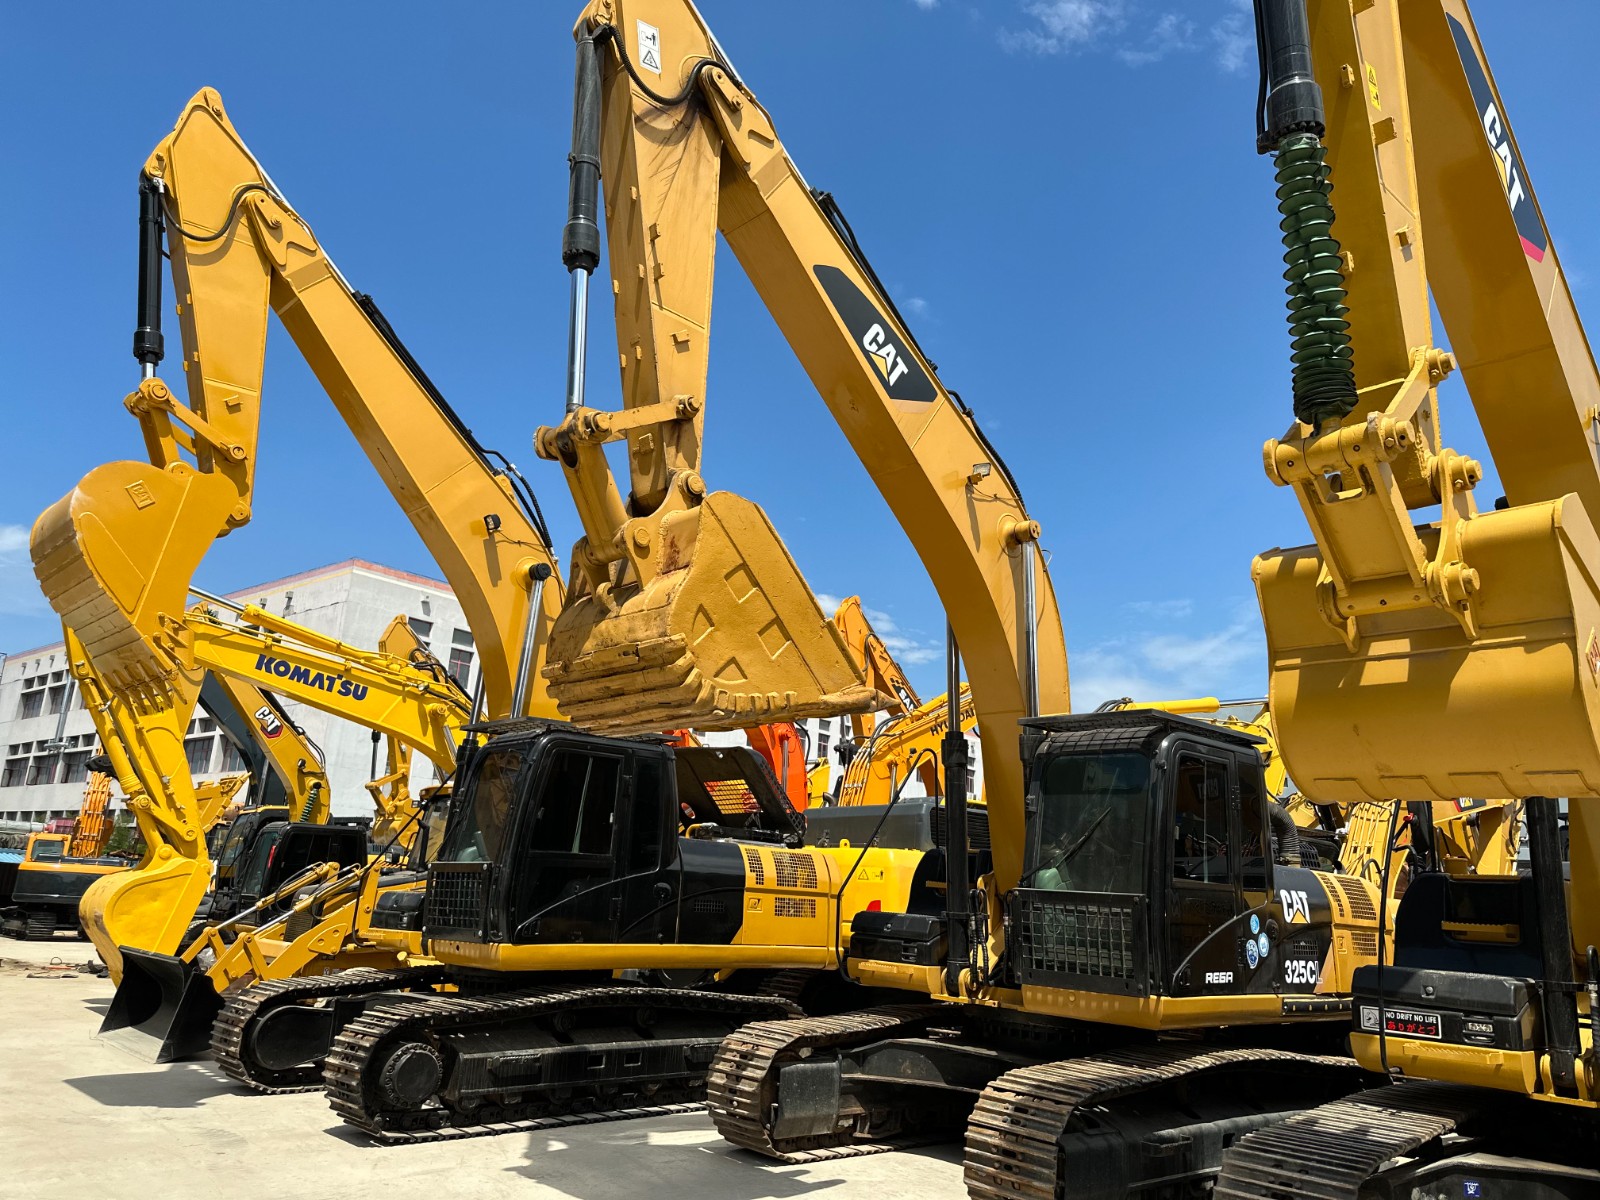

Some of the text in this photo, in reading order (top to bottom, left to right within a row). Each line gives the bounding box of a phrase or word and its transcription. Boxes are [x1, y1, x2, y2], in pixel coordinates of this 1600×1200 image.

[1483, 102, 1525, 212] CAT
[863, 323, 909, 387] CAT
[255, 653, 369, 701] KOMATSU
[254, 706, 281, 732] CAT
[930, 707, 975, 736] HYDAI
[1279, 889, 1310, 923] CAT
[1385, 1011, 1437, 1024] NO DRIFT NO LIFE
